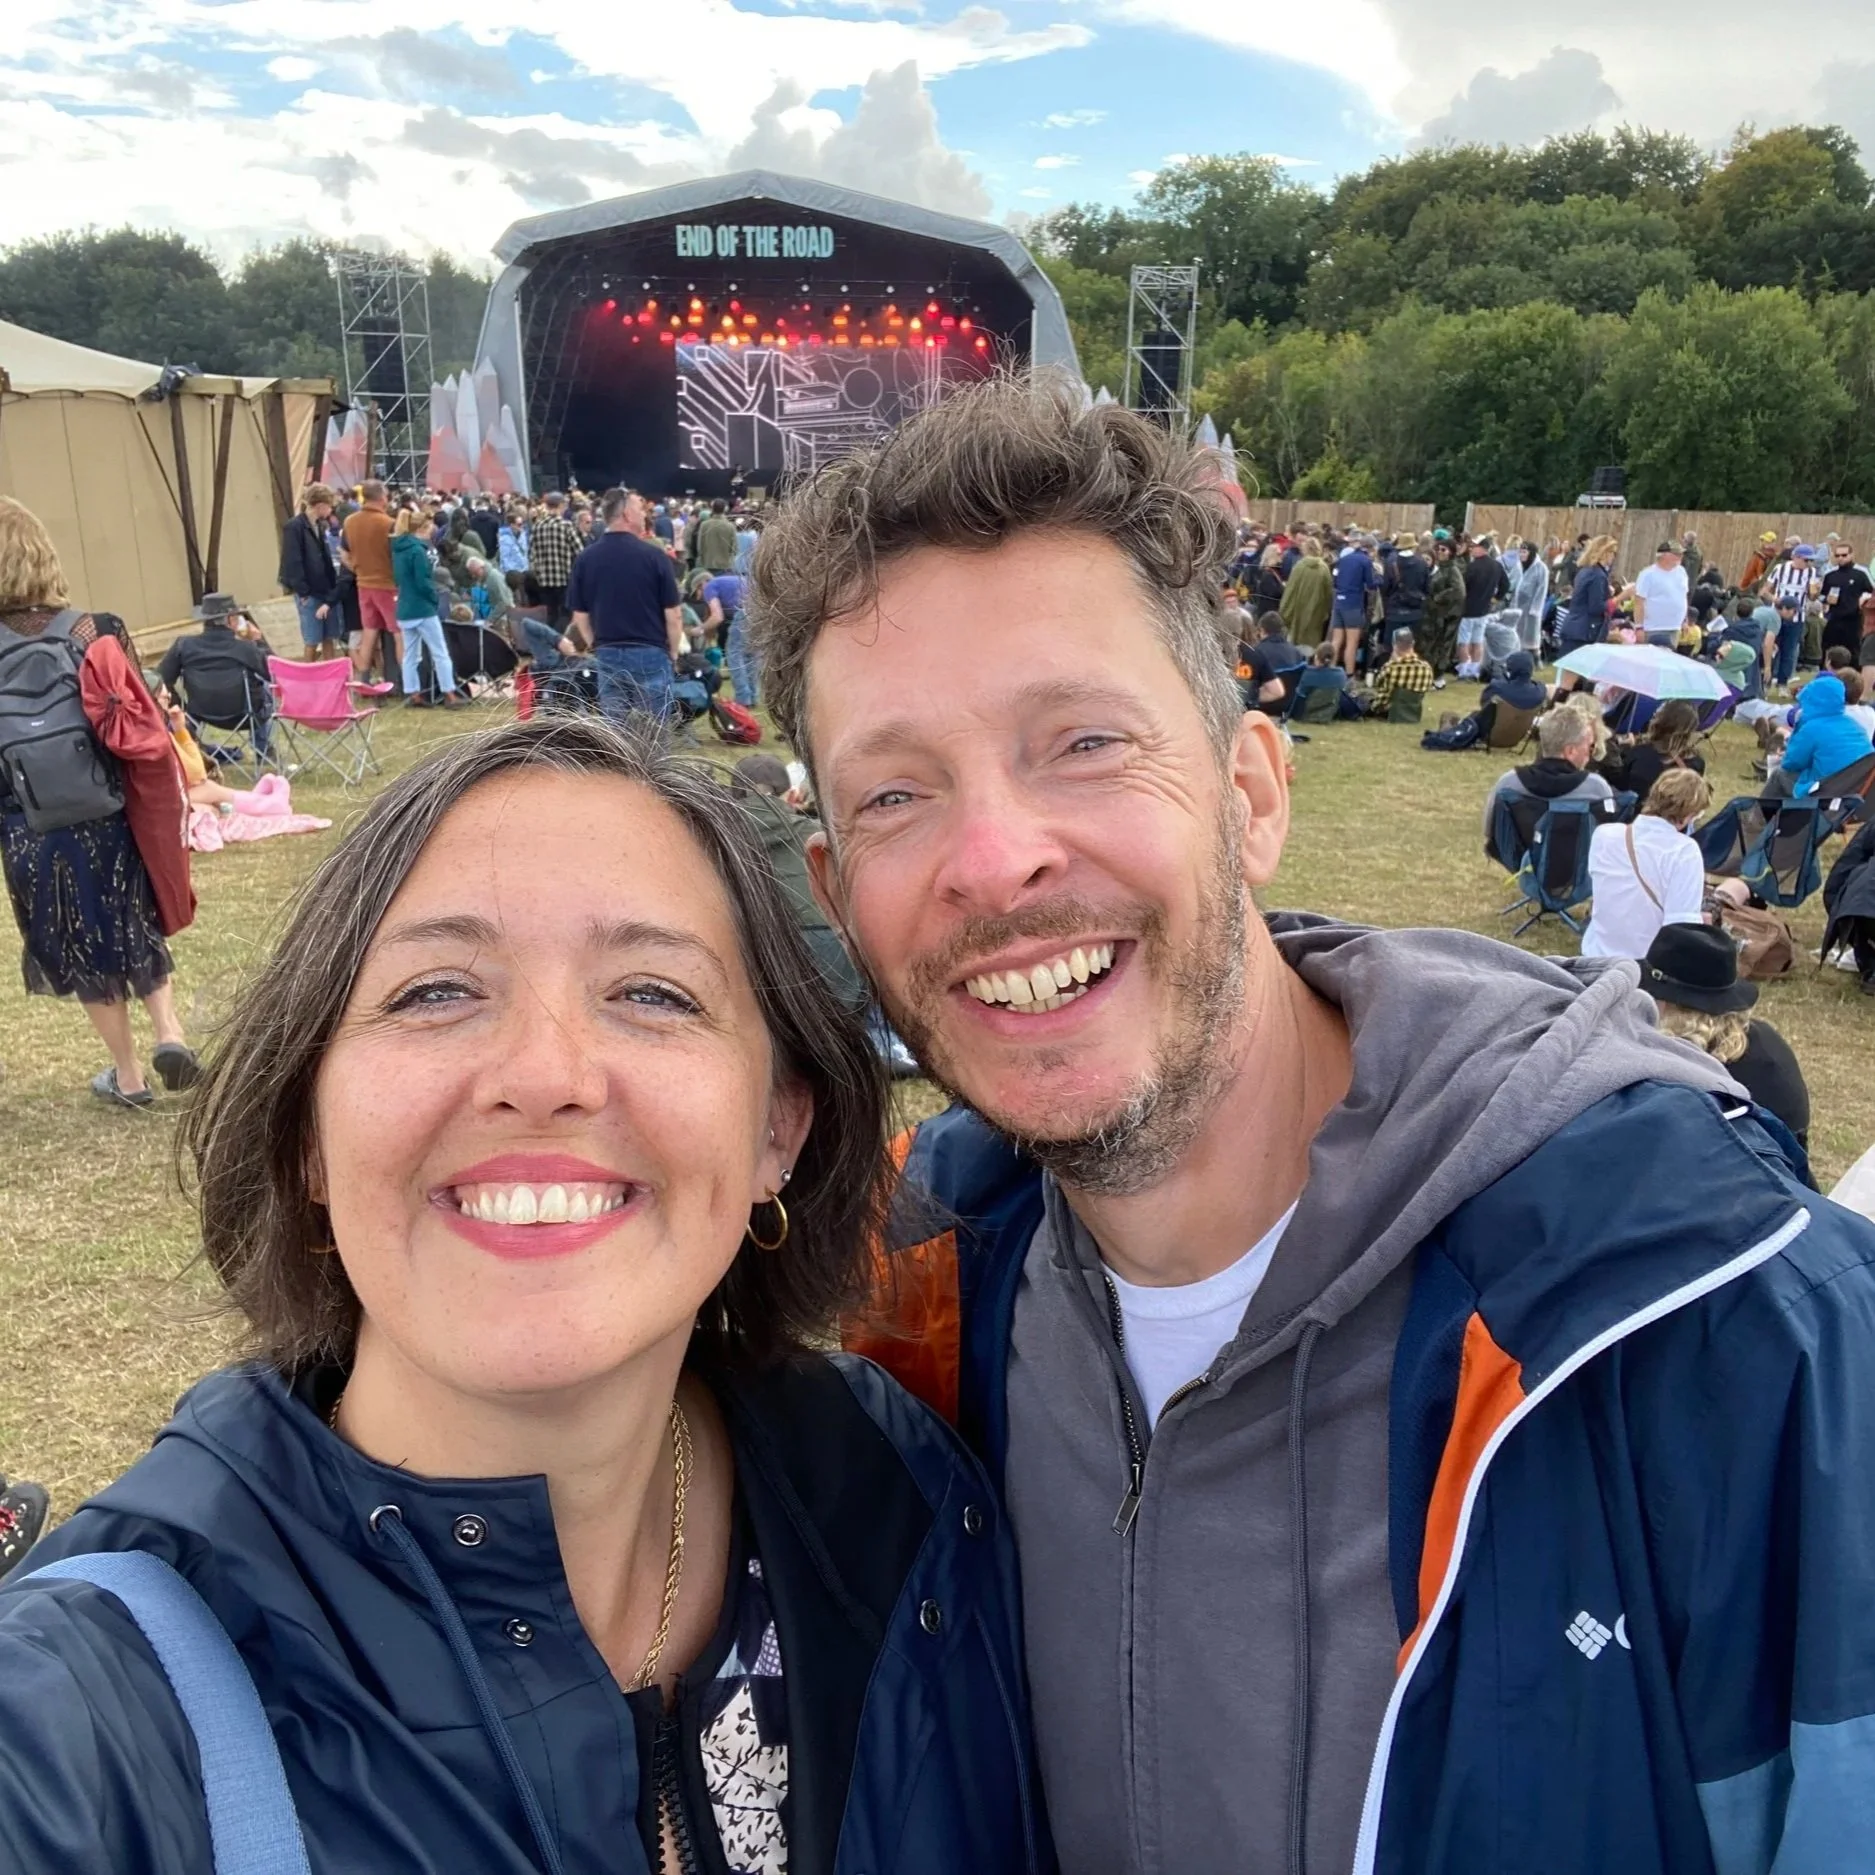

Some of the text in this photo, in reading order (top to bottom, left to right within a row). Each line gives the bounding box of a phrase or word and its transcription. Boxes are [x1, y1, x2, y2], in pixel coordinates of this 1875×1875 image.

[675, 225, 834, 258] END OF THE ROAD
